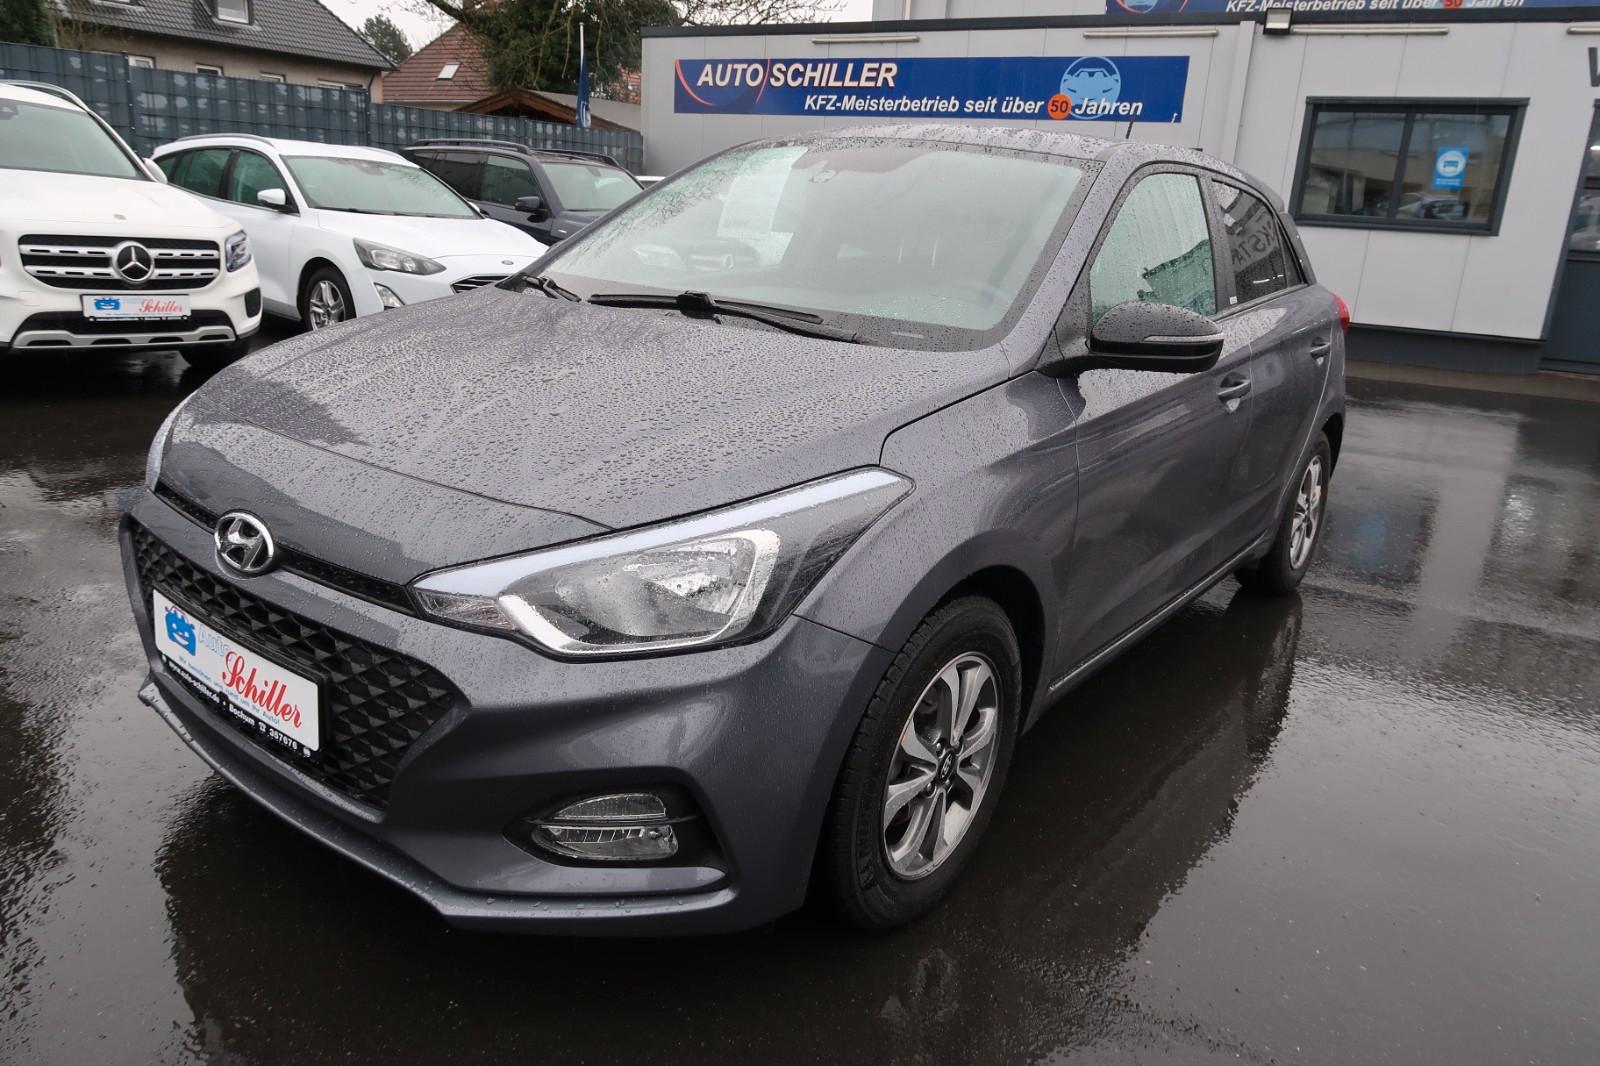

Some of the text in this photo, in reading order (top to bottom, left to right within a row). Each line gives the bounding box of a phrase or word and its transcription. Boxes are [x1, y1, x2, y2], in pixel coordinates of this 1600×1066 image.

[696, 62, 898, 87] AUTO SCHILLER
[804, 94, 1143, 116] KFZ-Meisterbetrieb seit über 50 Jahren
[139, 299, 183, 313] Schiller
[222, 651, 302, 728] Schiller
[229, 703, 256, 727] Bochum
